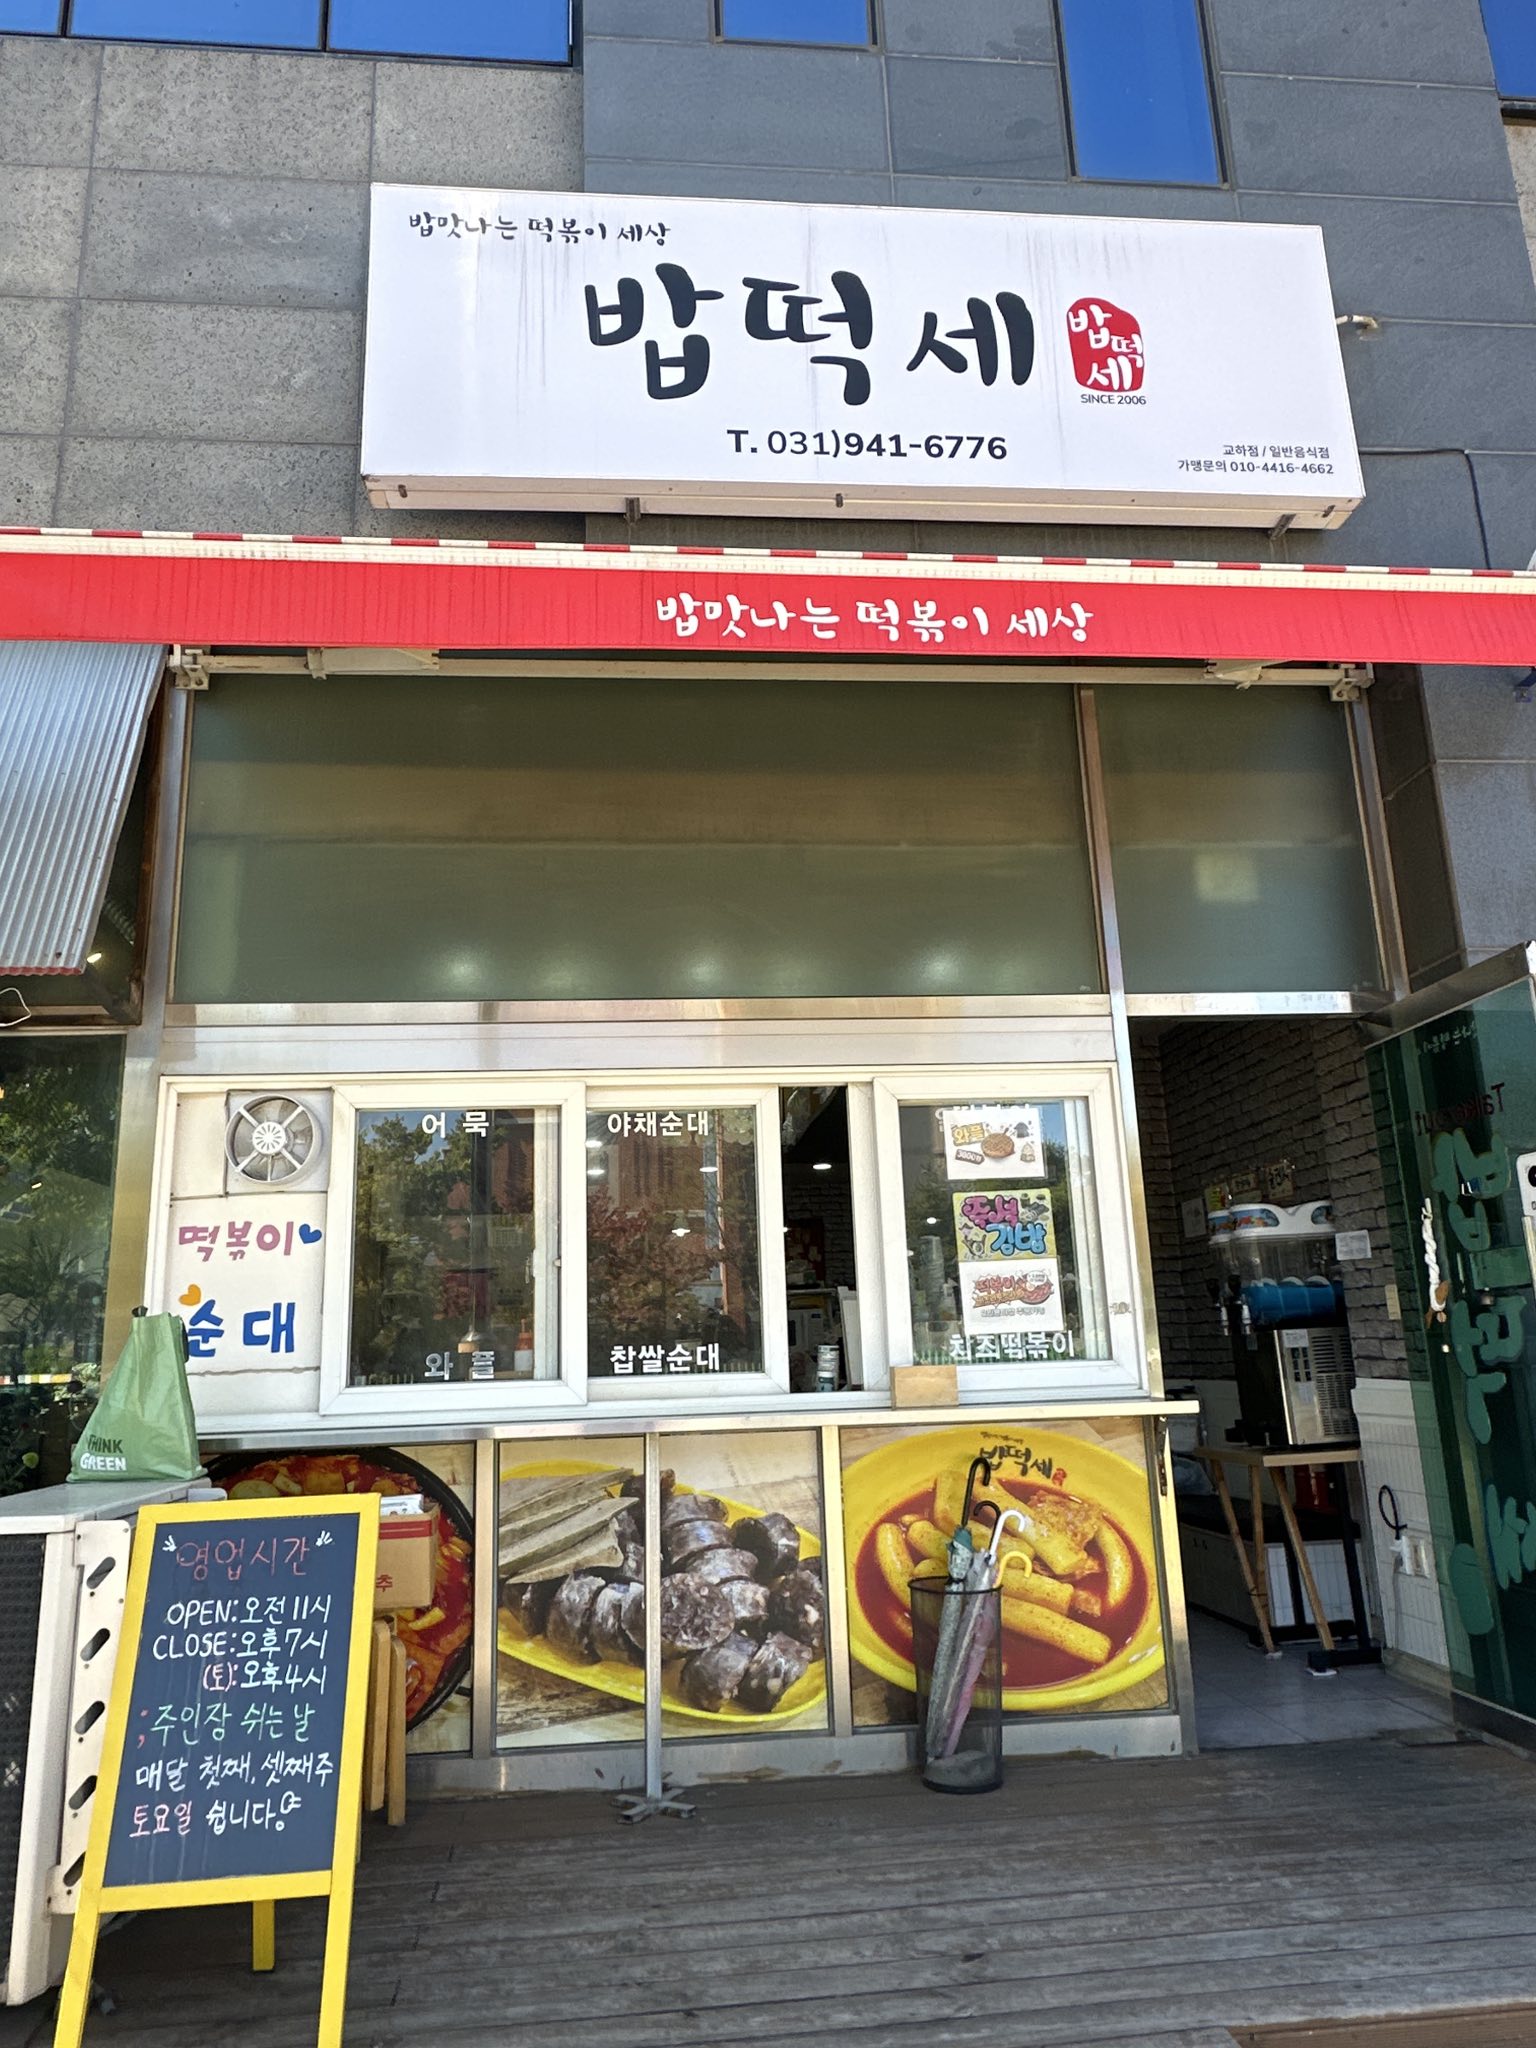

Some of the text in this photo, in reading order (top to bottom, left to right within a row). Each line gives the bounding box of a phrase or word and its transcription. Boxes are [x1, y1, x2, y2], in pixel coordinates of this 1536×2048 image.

[409, 211, 671, 247] 밥맛나는 떡볶이 세상
[1080, 393, 1147, 406] SINCE 2006
[726, 429, 1007, 461] T. 031)941-6776
[1223, 444, 1259, 458] 교하점
[1269, 445, 1330, 460] 일반음식점
[1178, 459, 1334, 475] 가맹문의 010-4416-4662
[656, 592, 1094, 643] 밥맛나는 떡볶이 세상
[607, 1110, 709, 1138] 야채순대
[178, 1221, 294, 1262] 떡볶이
[984, 1222, 1047, 1257] 김밥
[609, 1343, 720, 1374] 찹쌀순대
[87, 1434, 124, 1454] THINK
[80, 1452, 127, 1471] GREEN
[176, 1536, 310, 1581] 영업시간
[240, 1702, 284, 1741] 쉬는
[293, 1702, 316, 1743] 날
[136, 1757, 190, 1793] 매달
[129, 1800, 193, 1838] 토요일
